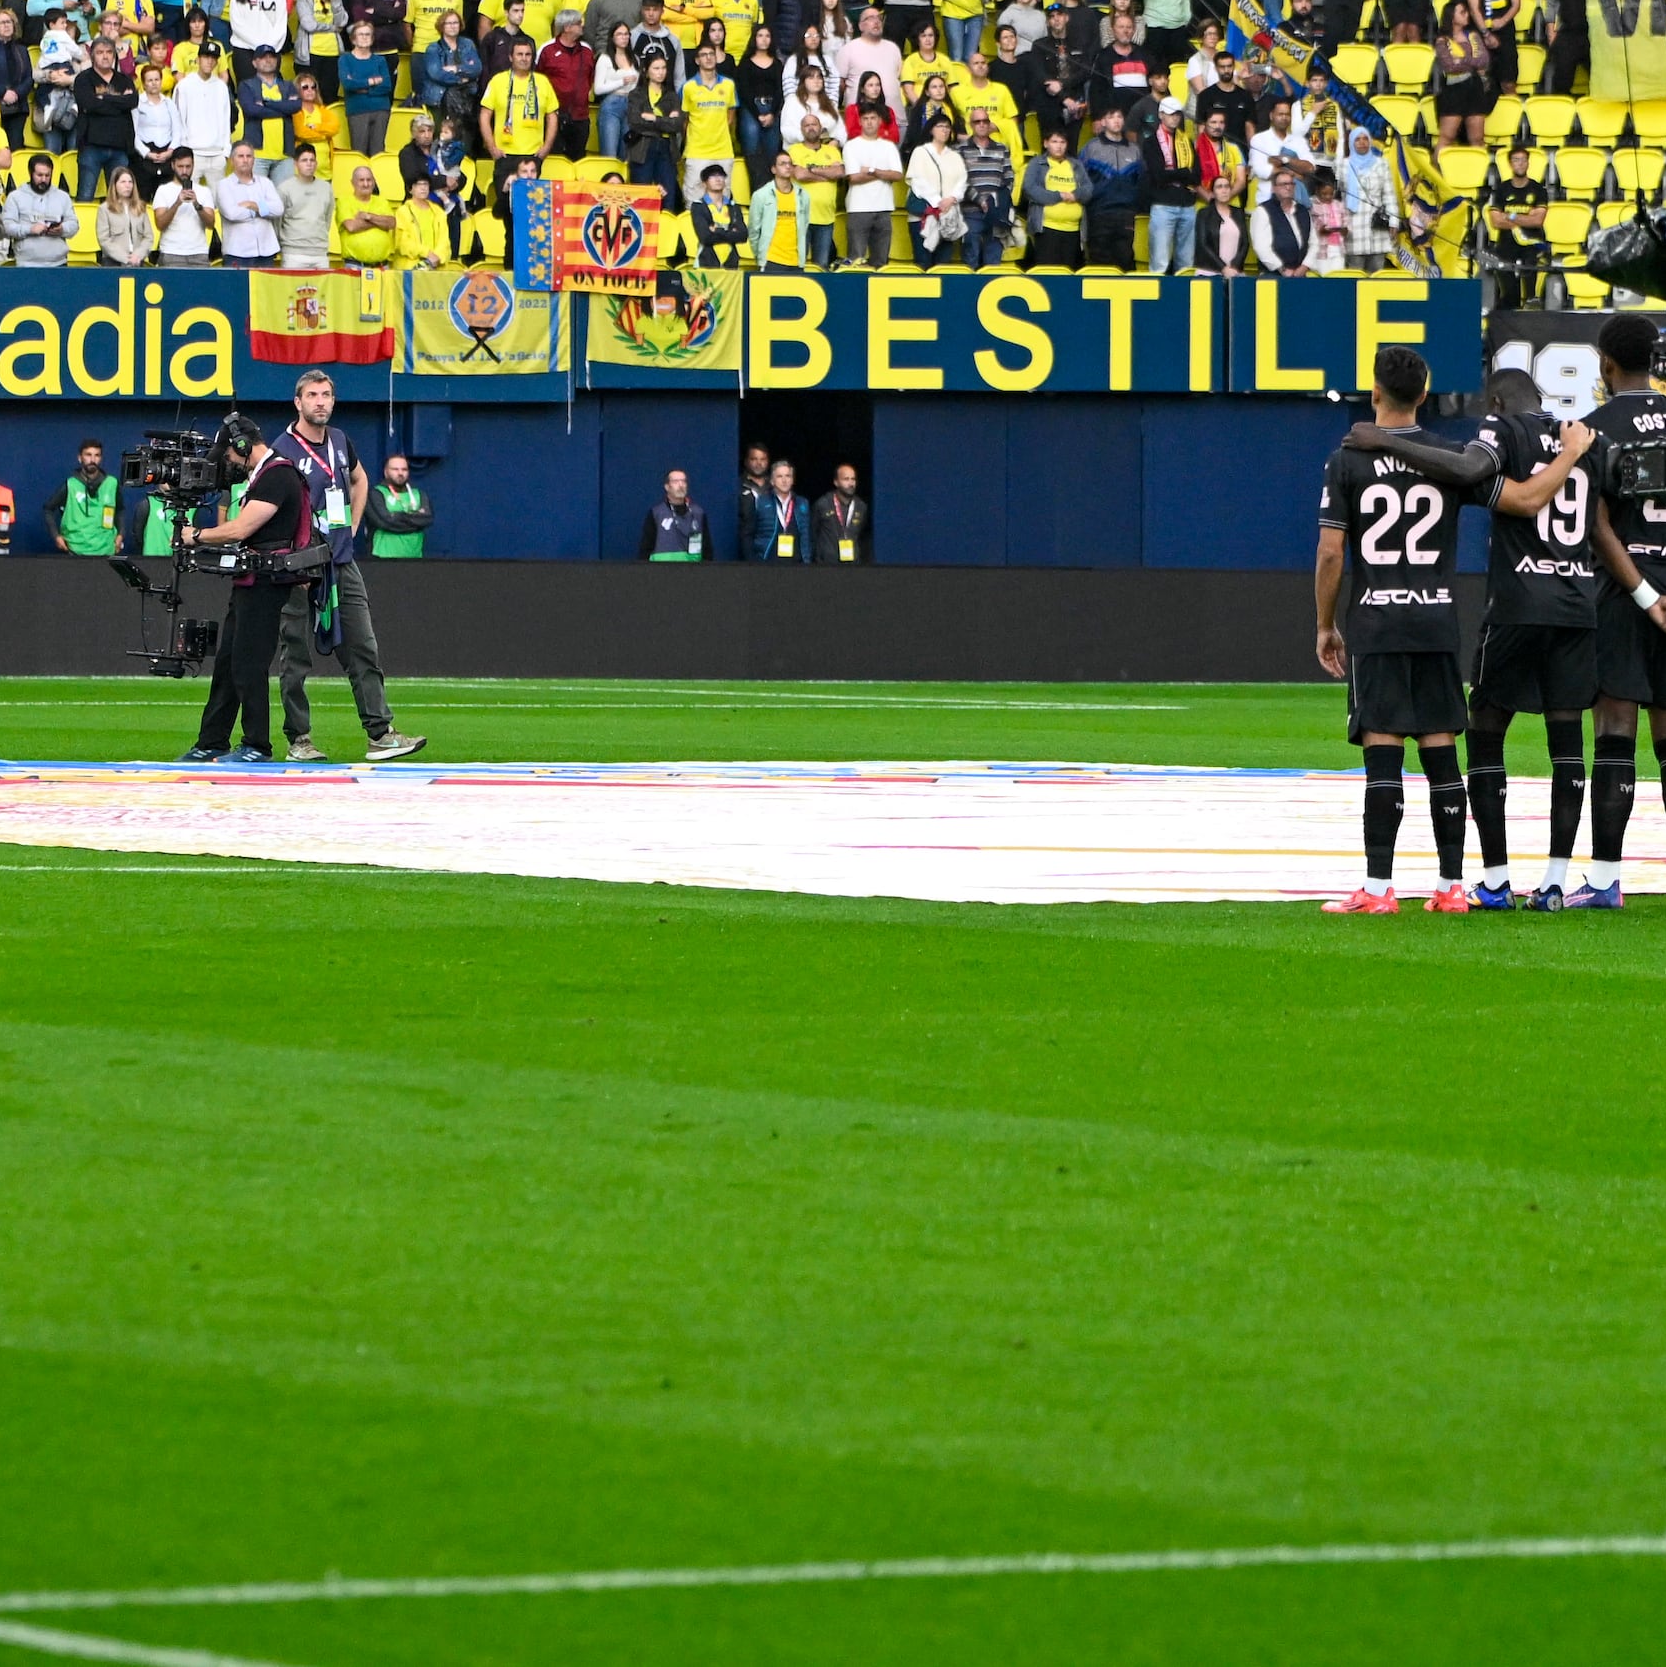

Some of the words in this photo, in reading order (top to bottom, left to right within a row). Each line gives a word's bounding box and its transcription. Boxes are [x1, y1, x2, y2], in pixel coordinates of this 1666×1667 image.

[572, 270, 596, 286] ON
[414, 300, 445, 311] 2012
[518, 298, 548, 310] 2022
[748, 275, 1431, 392] BESTILE
[1360, 484, 1444, 565] 22
[1359, 587, 1453, 606] ASCALE
